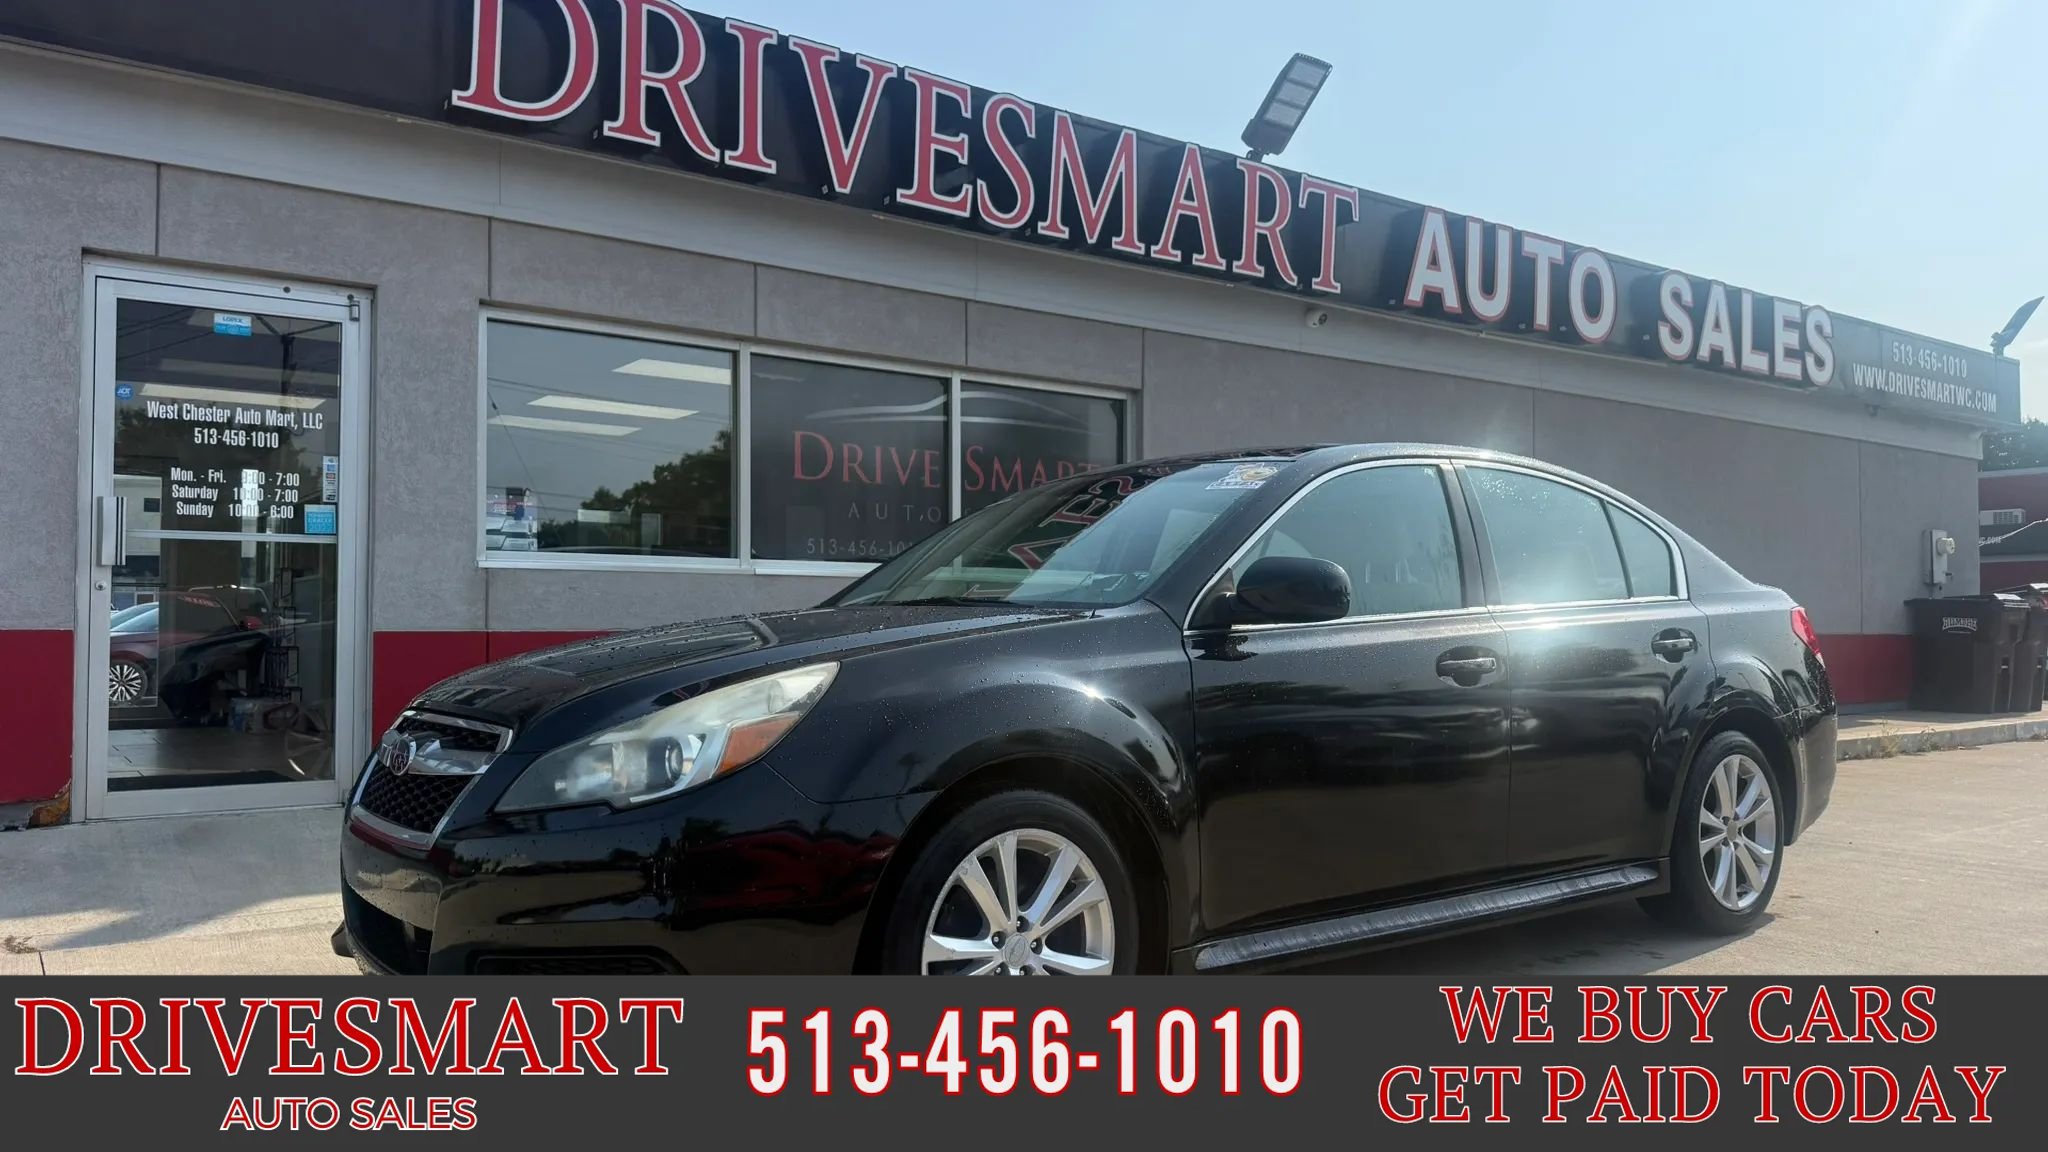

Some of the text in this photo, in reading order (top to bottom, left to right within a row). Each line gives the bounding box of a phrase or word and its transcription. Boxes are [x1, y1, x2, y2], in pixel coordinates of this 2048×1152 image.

[451, 0, 1359, 295] DRIVESMART
[1403, 205, 1835, 387] AUTO SALES
[1892, 341, 1967, 378] 513-456-1010
[1852, 363, 1997, 413] WWW.DRIVESMARTWC.COM
[147, 400, 323, 430] West Chester Auto Mart, LLC
[194, 427, 279, 449] 513-456-1010
[792, 430, 942, 489] DRIVE
[170, 466, 197, 482] Mon.
[208, 468, 227, 484] Fri.
[275, 472, 300, 487] 7:00
[171, 483, 219, 502] Saturday
[232, 486, 264, 501] 10:00
[273, 488, 299, 503] 7:00
[176, 501, 214, 519] Sunday
[270, 504, 294, 519] 6:00
[848, 502, 942, 523] AUTO
